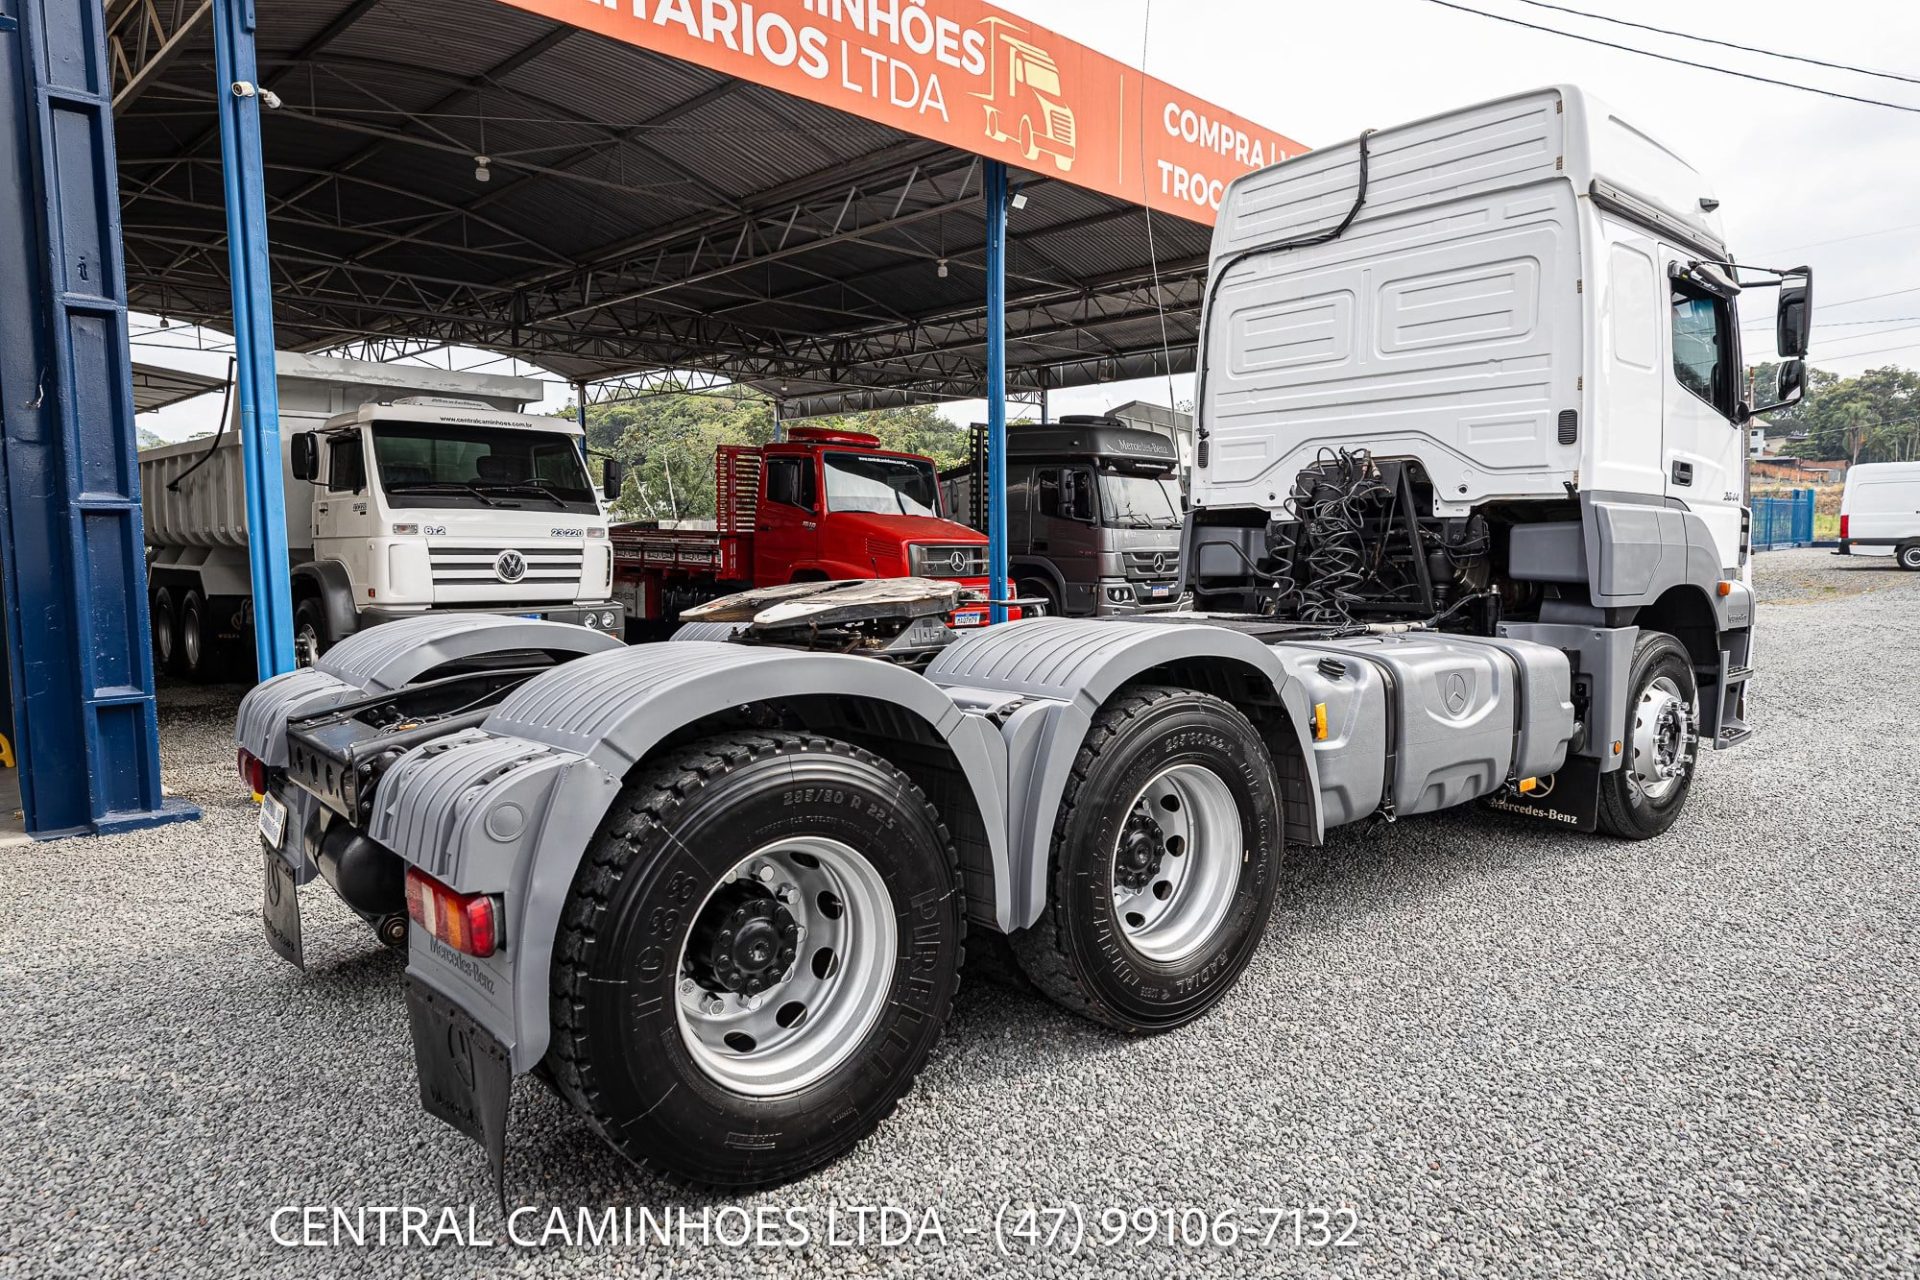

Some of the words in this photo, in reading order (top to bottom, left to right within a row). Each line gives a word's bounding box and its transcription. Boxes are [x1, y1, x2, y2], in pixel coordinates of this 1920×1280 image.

[841, 39, 949, 123] LTDA
[1163, 102, 1265, 169] COMPRA
[424, 525, 447, 536] 6x2
[430, 933, 495, 995] Mercedes-Benz
[869, 887, 942, 1079] PIRELLI
